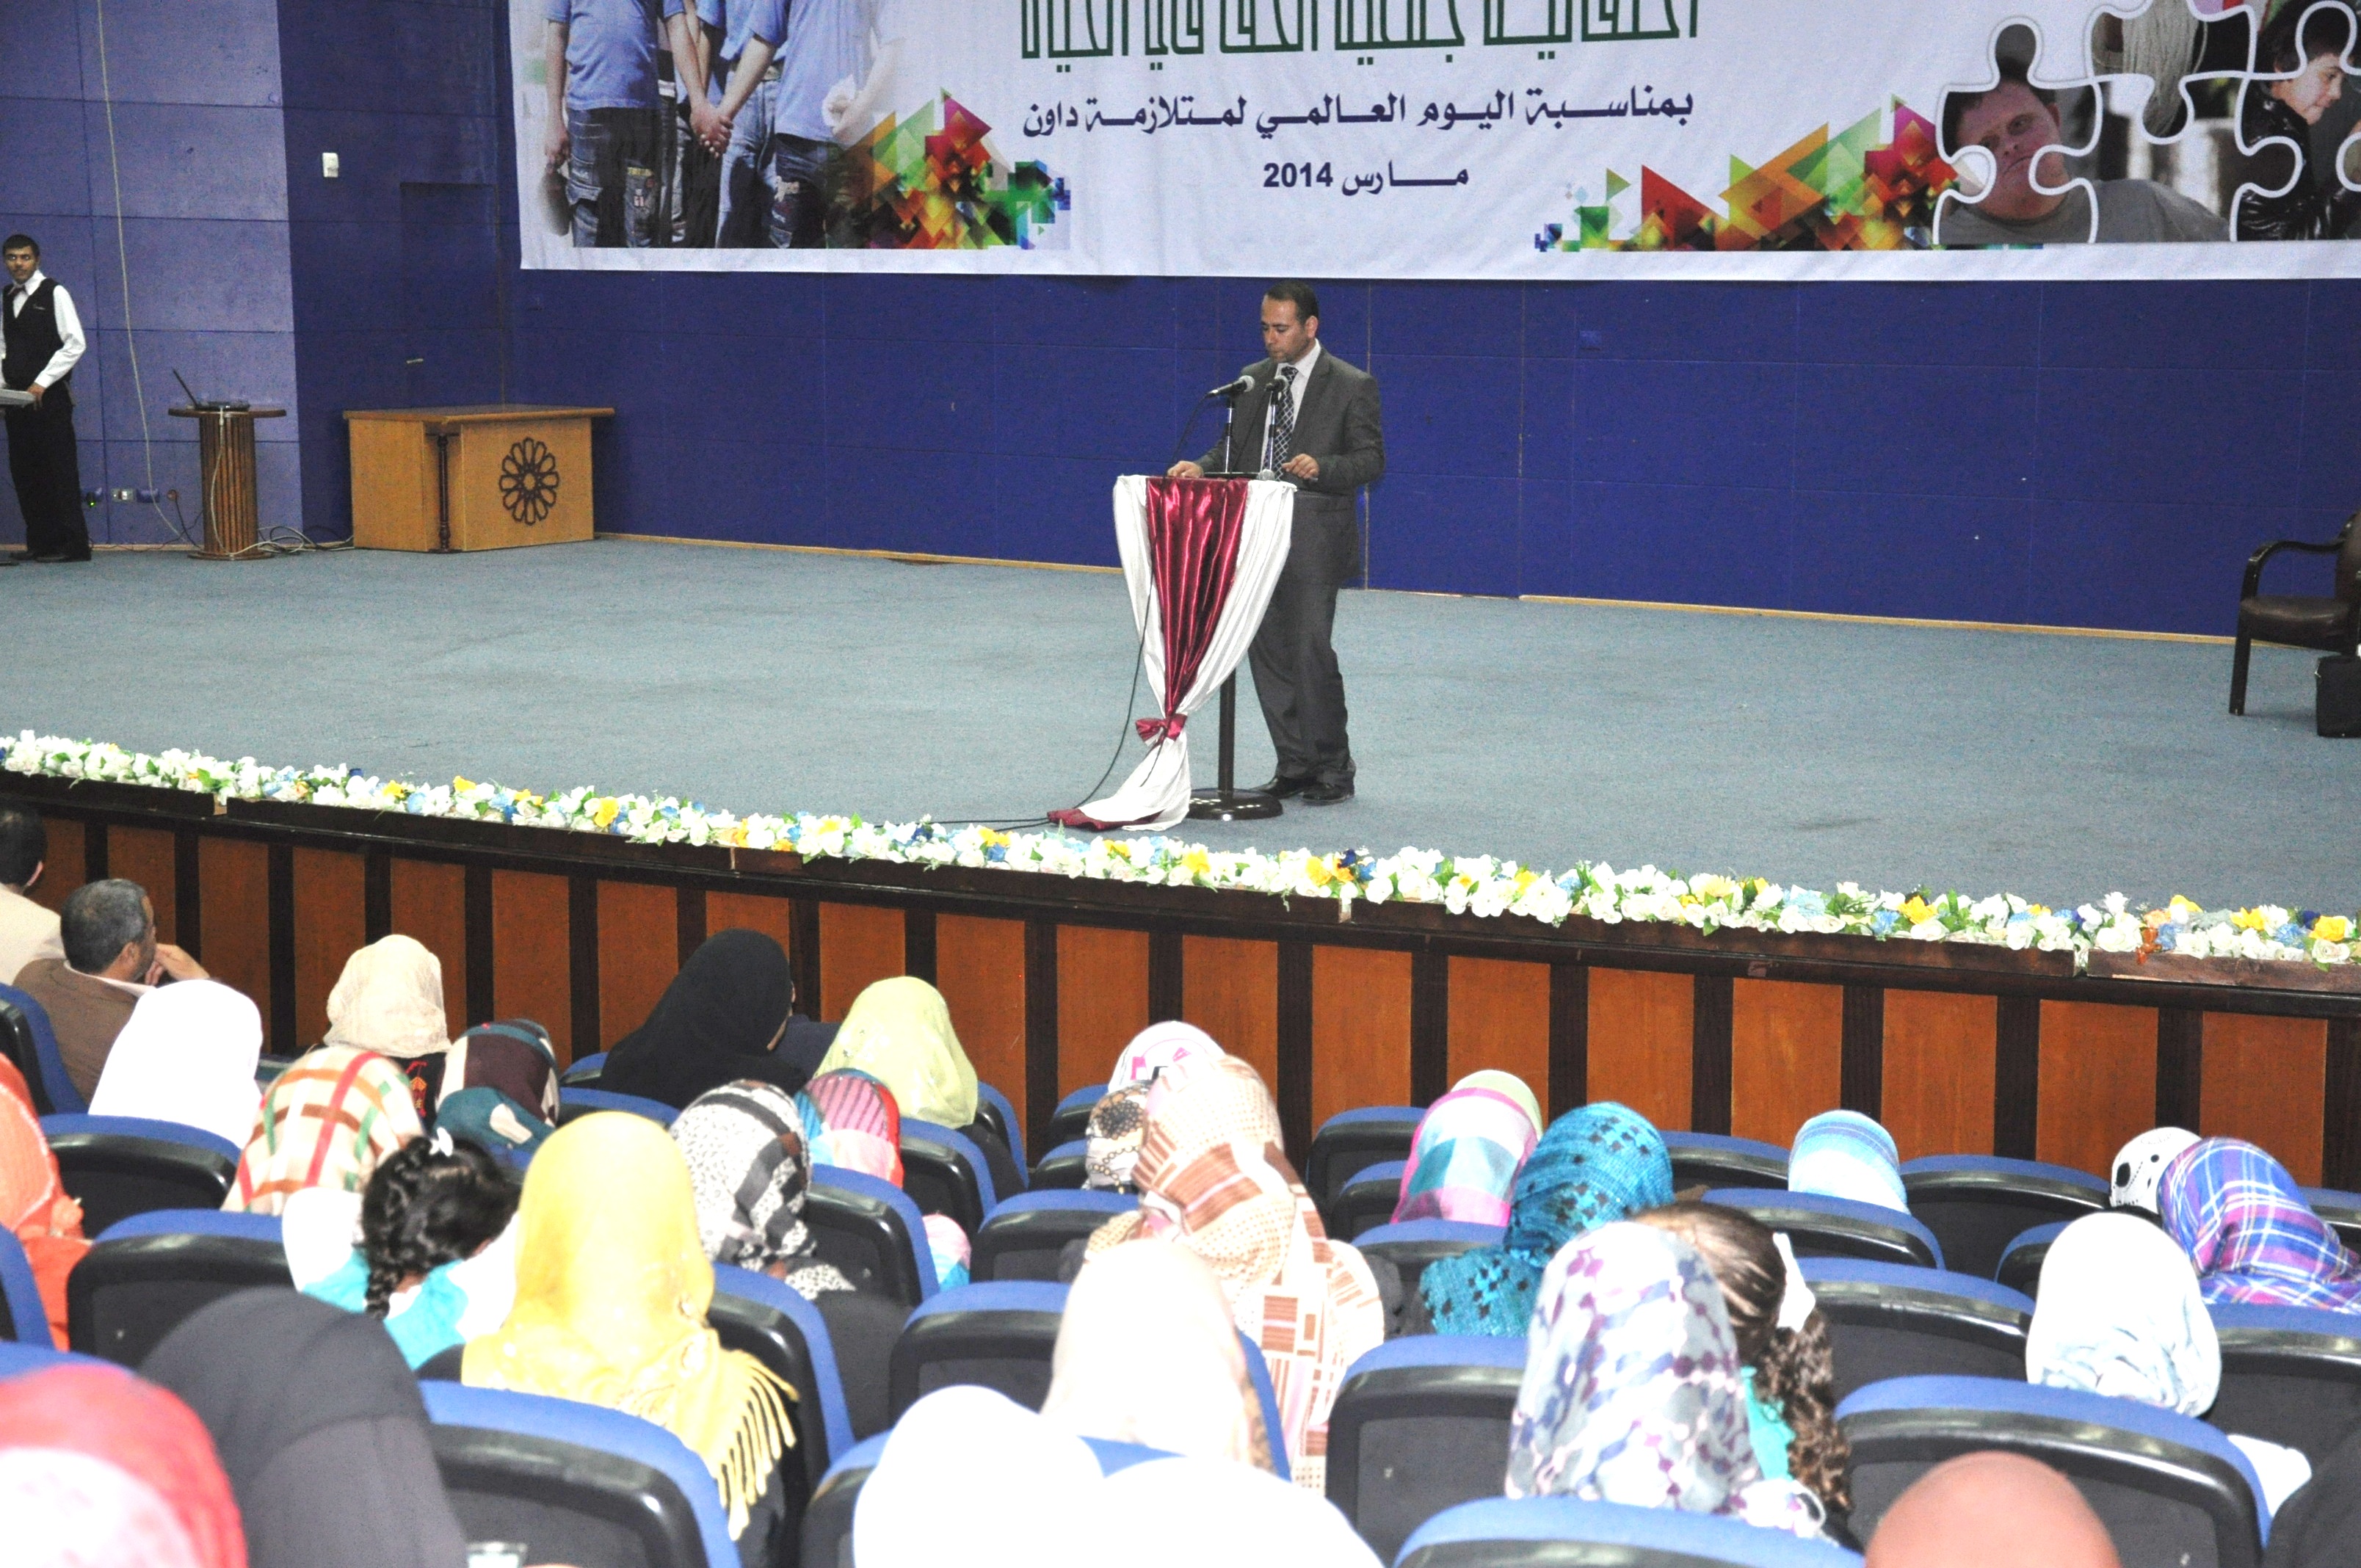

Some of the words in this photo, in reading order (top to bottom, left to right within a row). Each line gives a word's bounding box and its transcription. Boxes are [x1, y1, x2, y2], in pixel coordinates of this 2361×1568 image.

[1023, 101, 1078, 137] داون
[1085, 95, 1247, 134] لمتلازمة
[1255, 92, 1405, 139] العالمي
[1416, 89, 1514, 130] اليوم
[1526, 84, 1694, 126] بمناسبة
[1263, 162, 1333, 188] 2014
[1341, 159, 1469, 197] مارس
